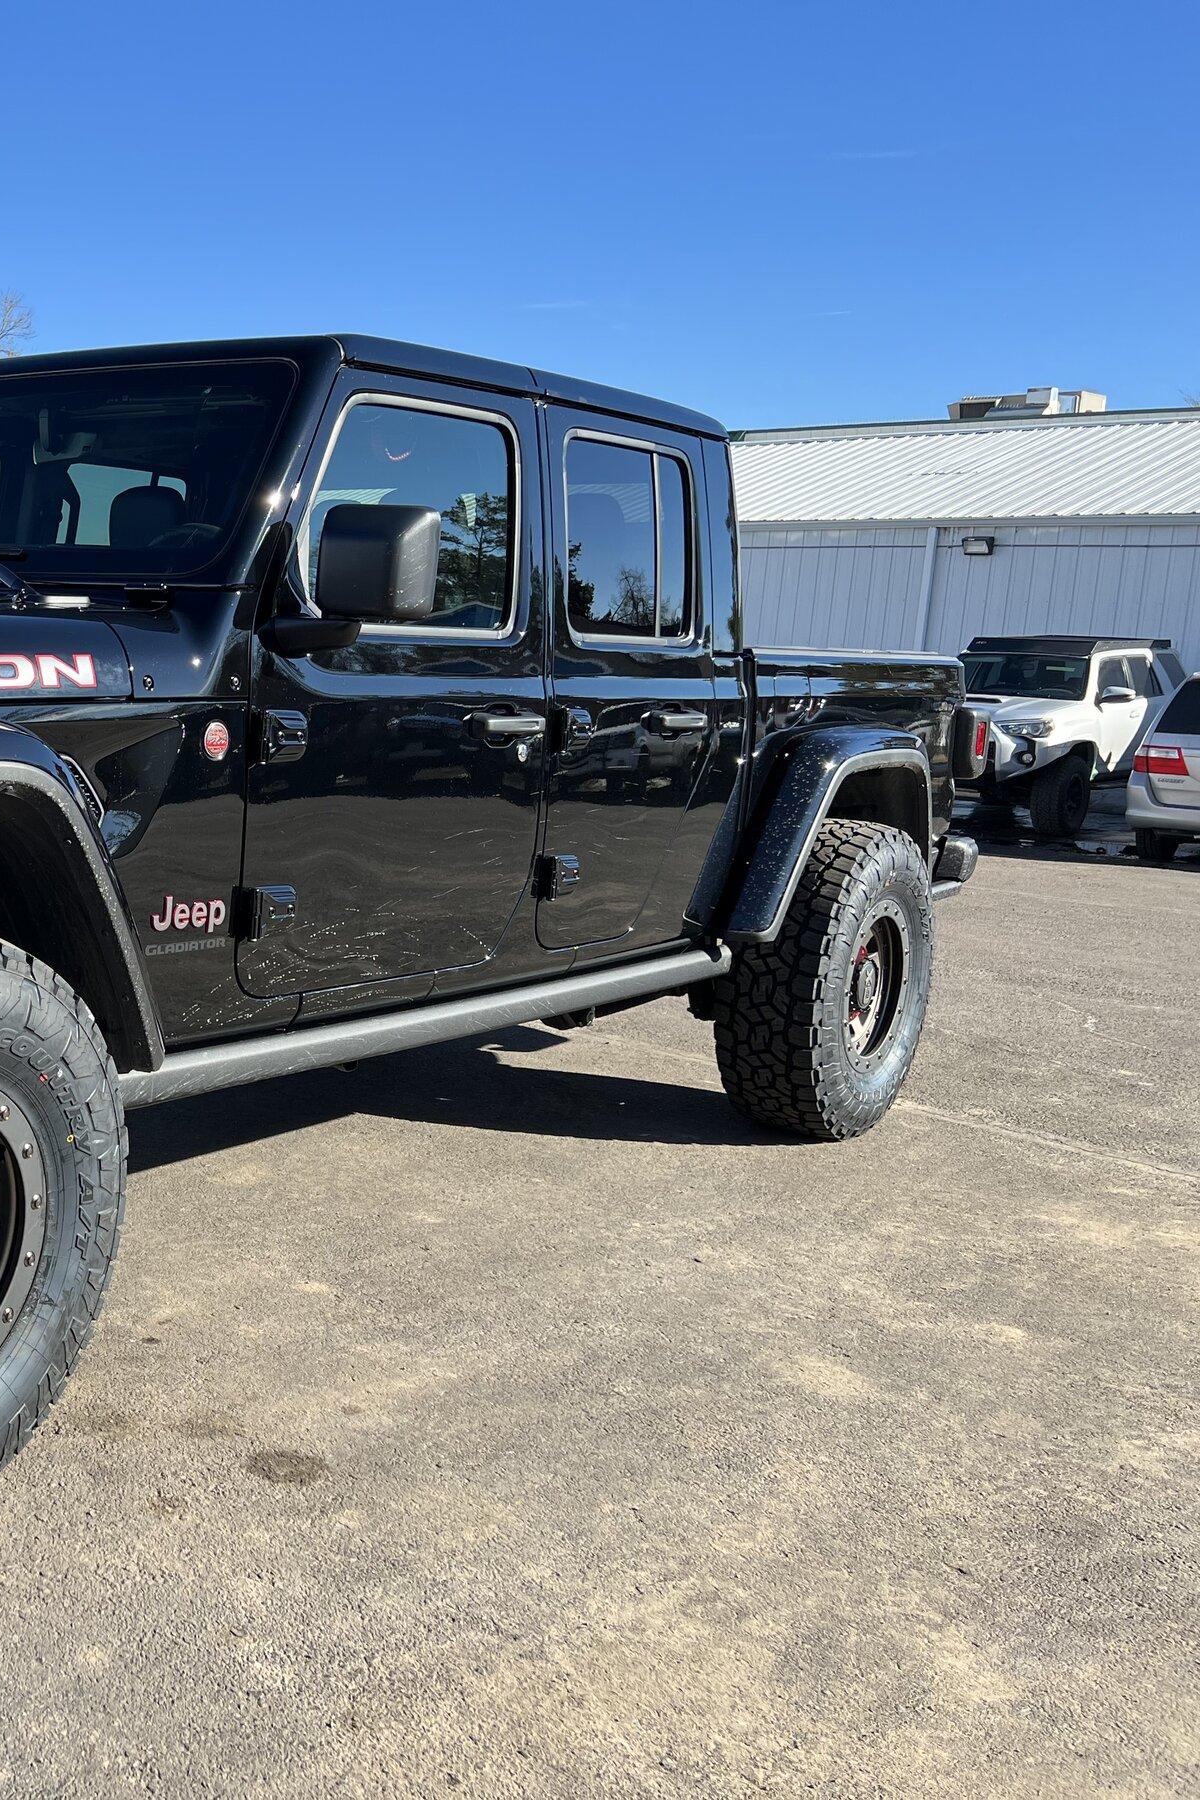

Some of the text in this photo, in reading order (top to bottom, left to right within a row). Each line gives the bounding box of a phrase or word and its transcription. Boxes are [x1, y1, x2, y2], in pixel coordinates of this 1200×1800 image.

[151, 895, 226, 933] Jeep
[145, 937, 226, 957] GLADIATOR
[75, 1171, 95, 1261] A/T
